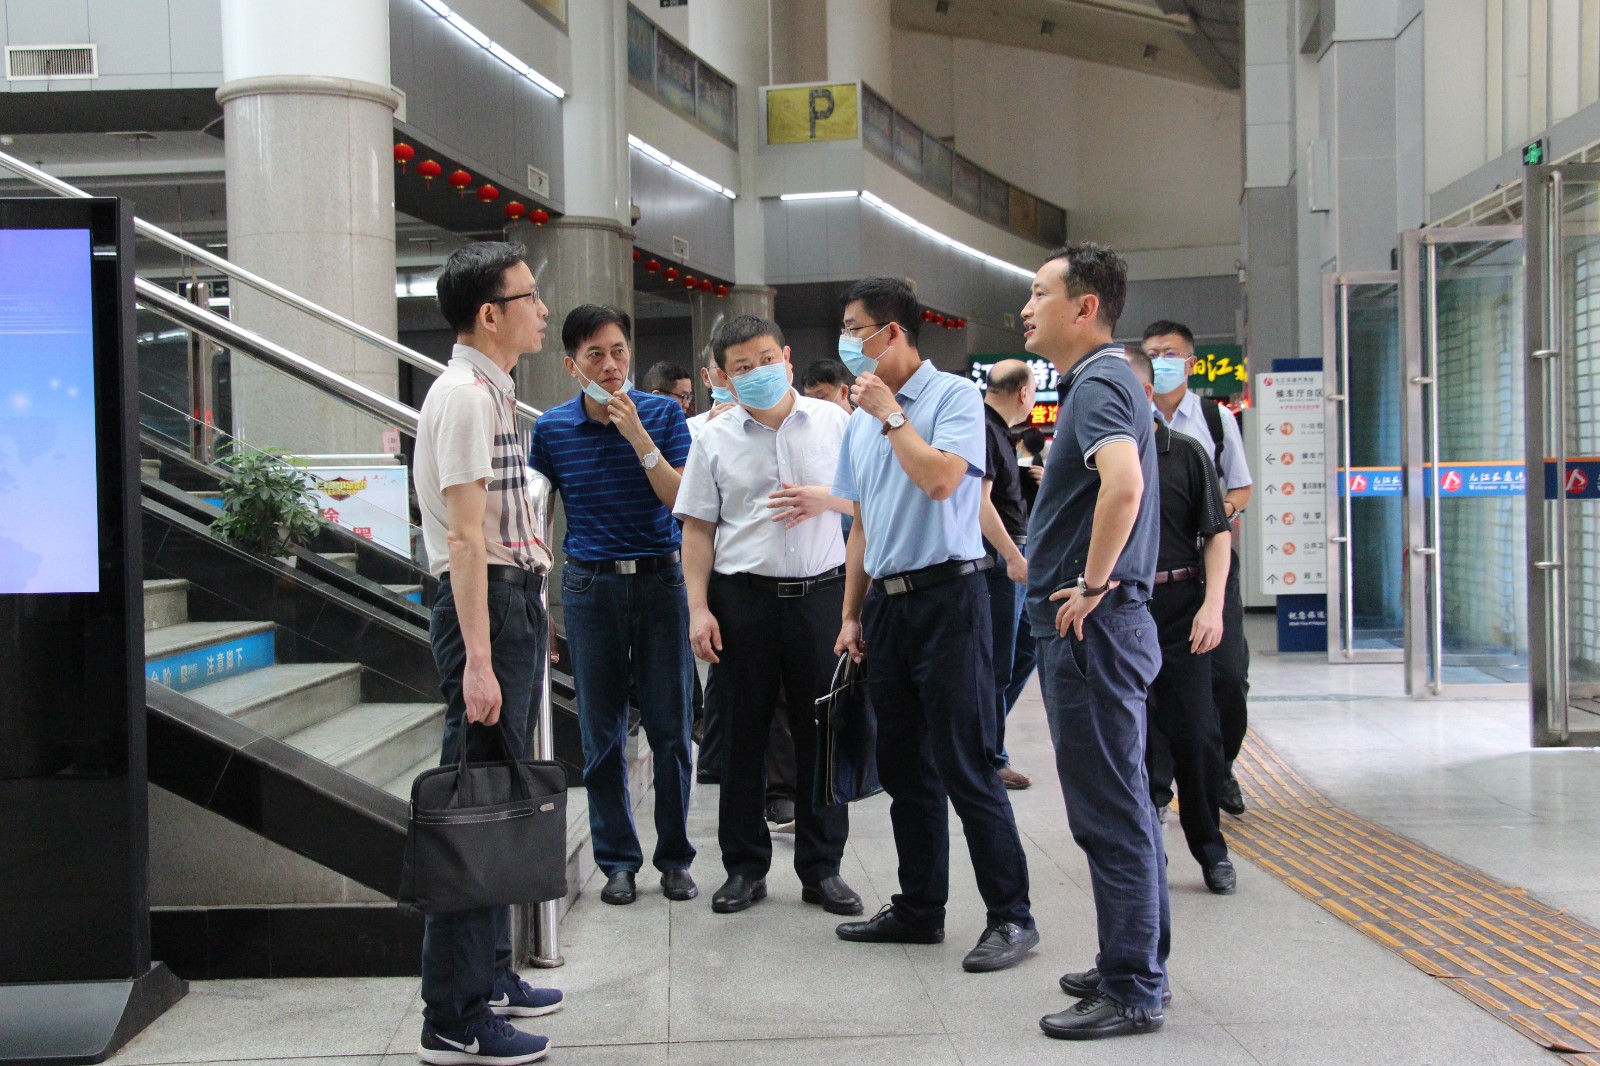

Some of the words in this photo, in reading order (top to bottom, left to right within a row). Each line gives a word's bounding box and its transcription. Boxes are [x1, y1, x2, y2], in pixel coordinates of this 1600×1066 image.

[808, 89, 835, 139] P
[206, 646, 243, 676] 注意脚下
